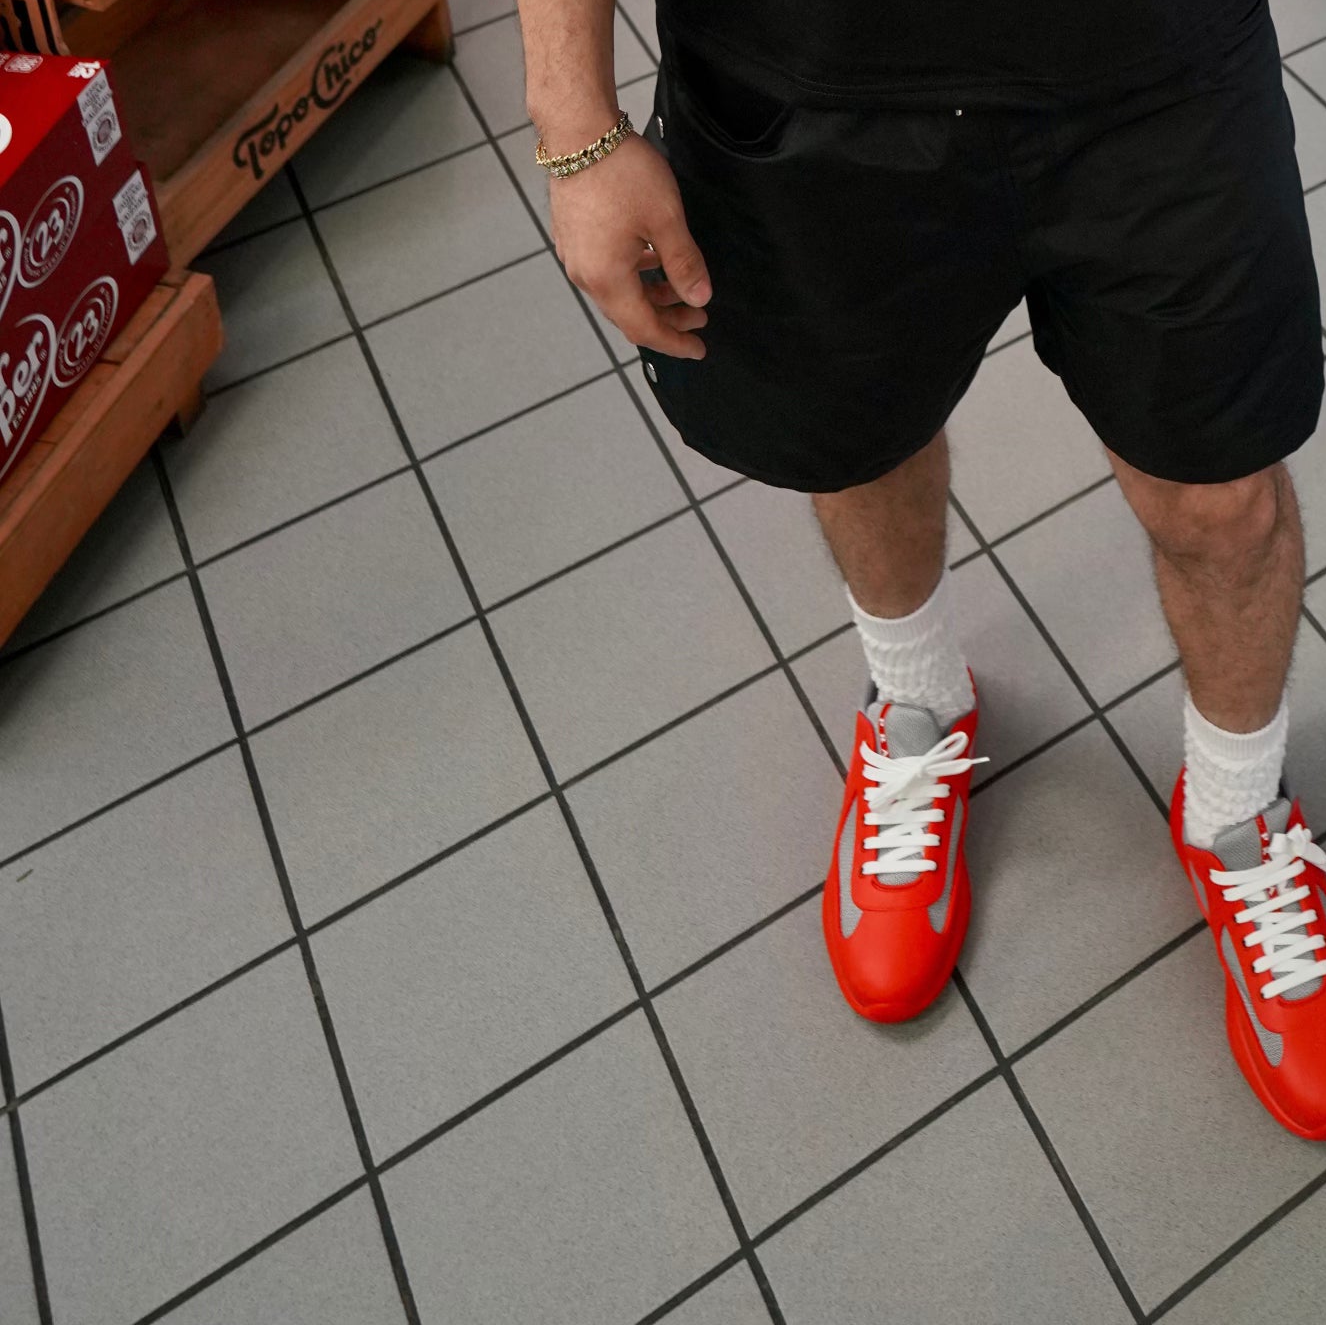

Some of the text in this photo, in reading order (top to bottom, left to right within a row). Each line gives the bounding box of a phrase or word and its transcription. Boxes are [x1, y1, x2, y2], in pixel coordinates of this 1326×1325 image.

[232, 18, 385, 181] Topo Chico
[35, 208, 65, 260] 23
[70, 308, 101, 359] 23
